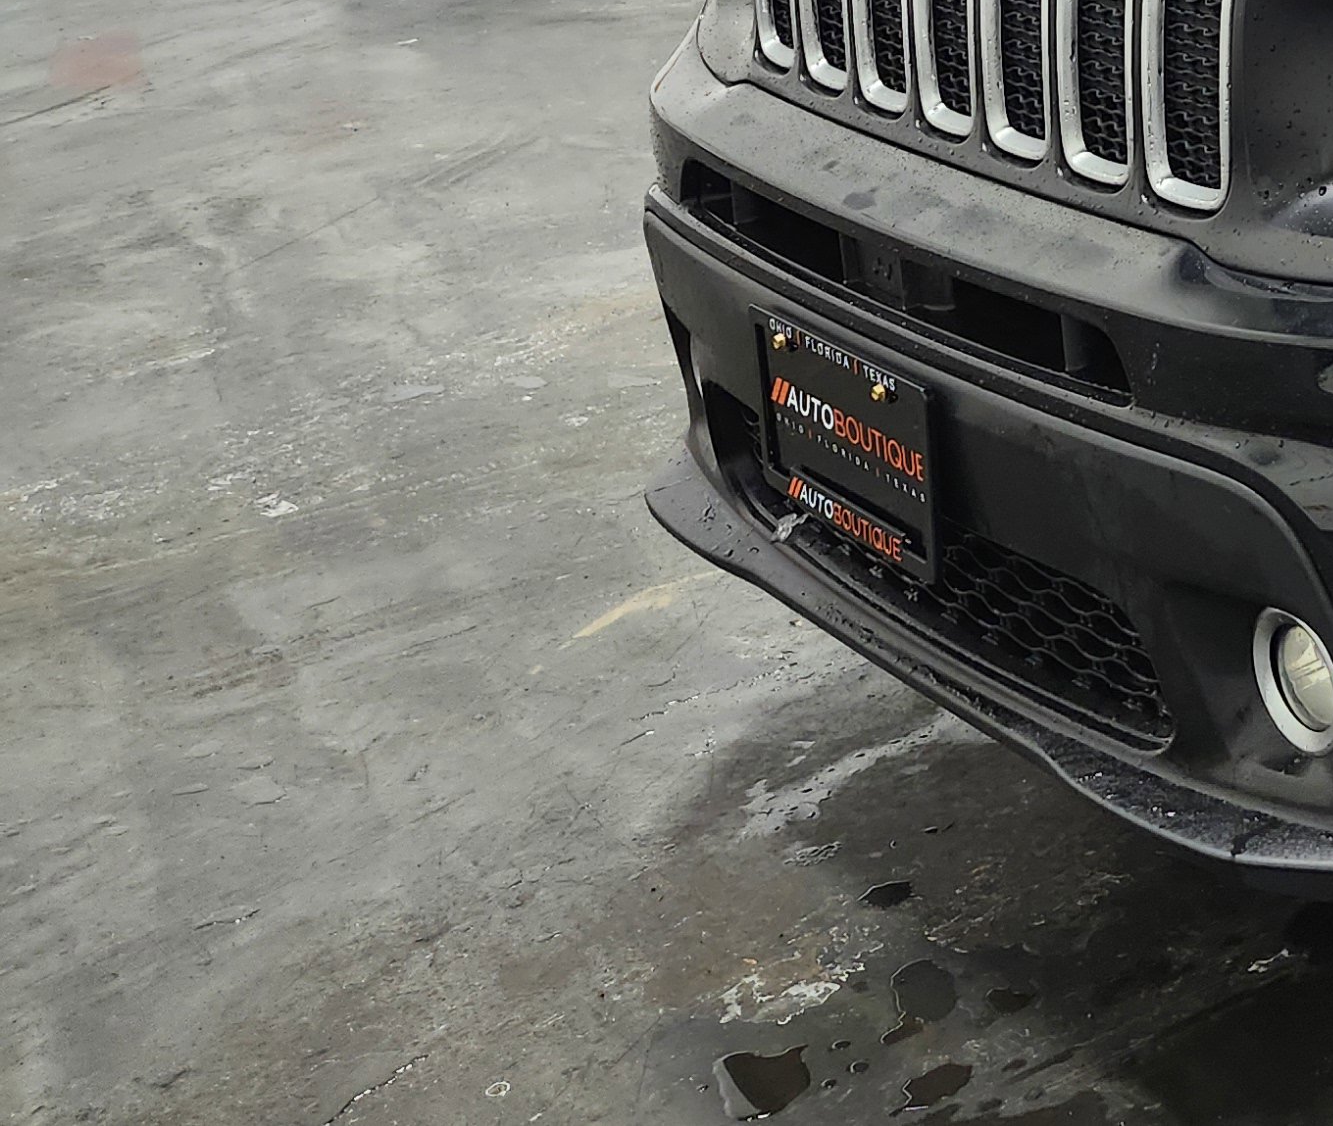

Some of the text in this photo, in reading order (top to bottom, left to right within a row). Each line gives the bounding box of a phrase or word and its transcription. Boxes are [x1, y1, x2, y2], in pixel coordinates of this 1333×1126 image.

[769, 318, 896, 391] OHIO FLORIDA TEXAS
[775, 412, 927, 504] OHIO FLORIDA TEXAS
